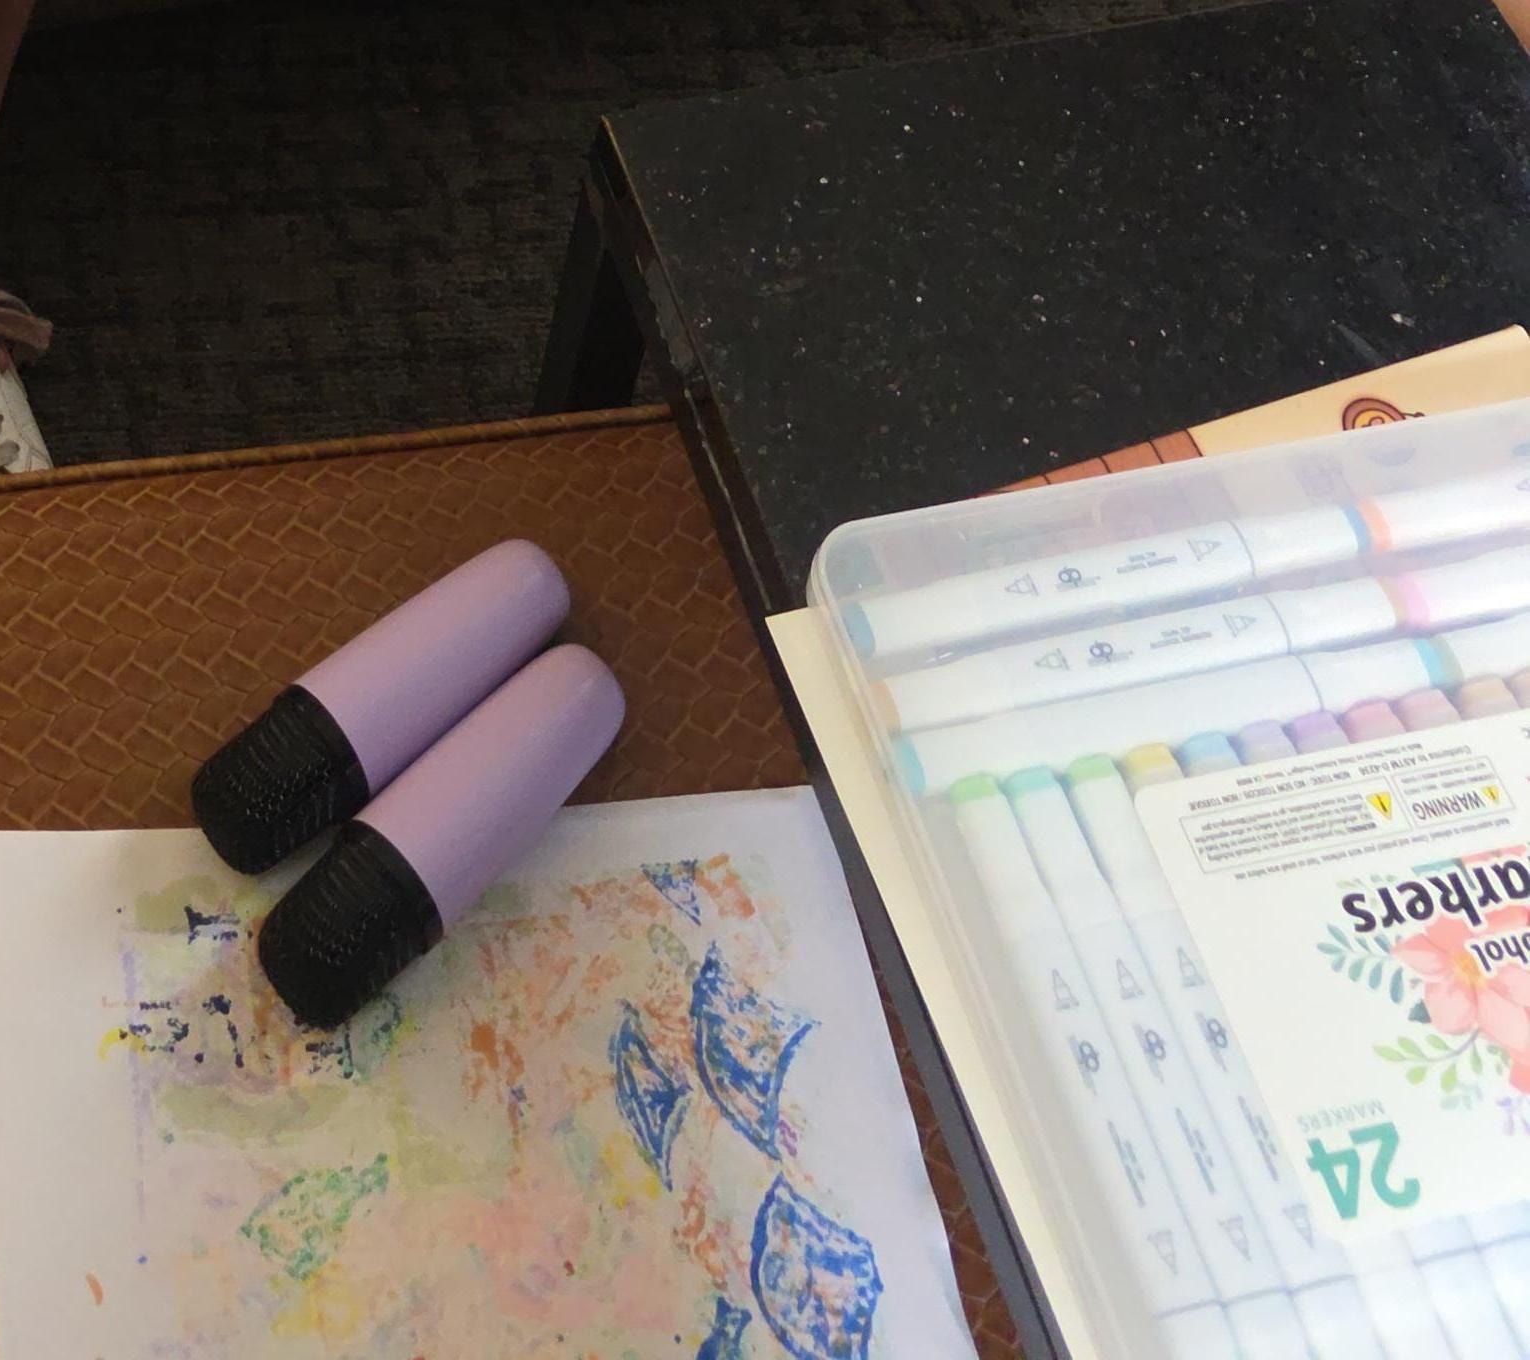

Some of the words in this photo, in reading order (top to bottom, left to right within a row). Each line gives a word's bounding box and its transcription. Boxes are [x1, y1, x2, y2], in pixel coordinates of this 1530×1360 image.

[1411, 790, 1486, 821] WARNING
[1341, 859, 1530, 933] arkers
[1296, 1099, 1385, 1133] MARKERS
[1306, 1121, 1421, 1220] 24
